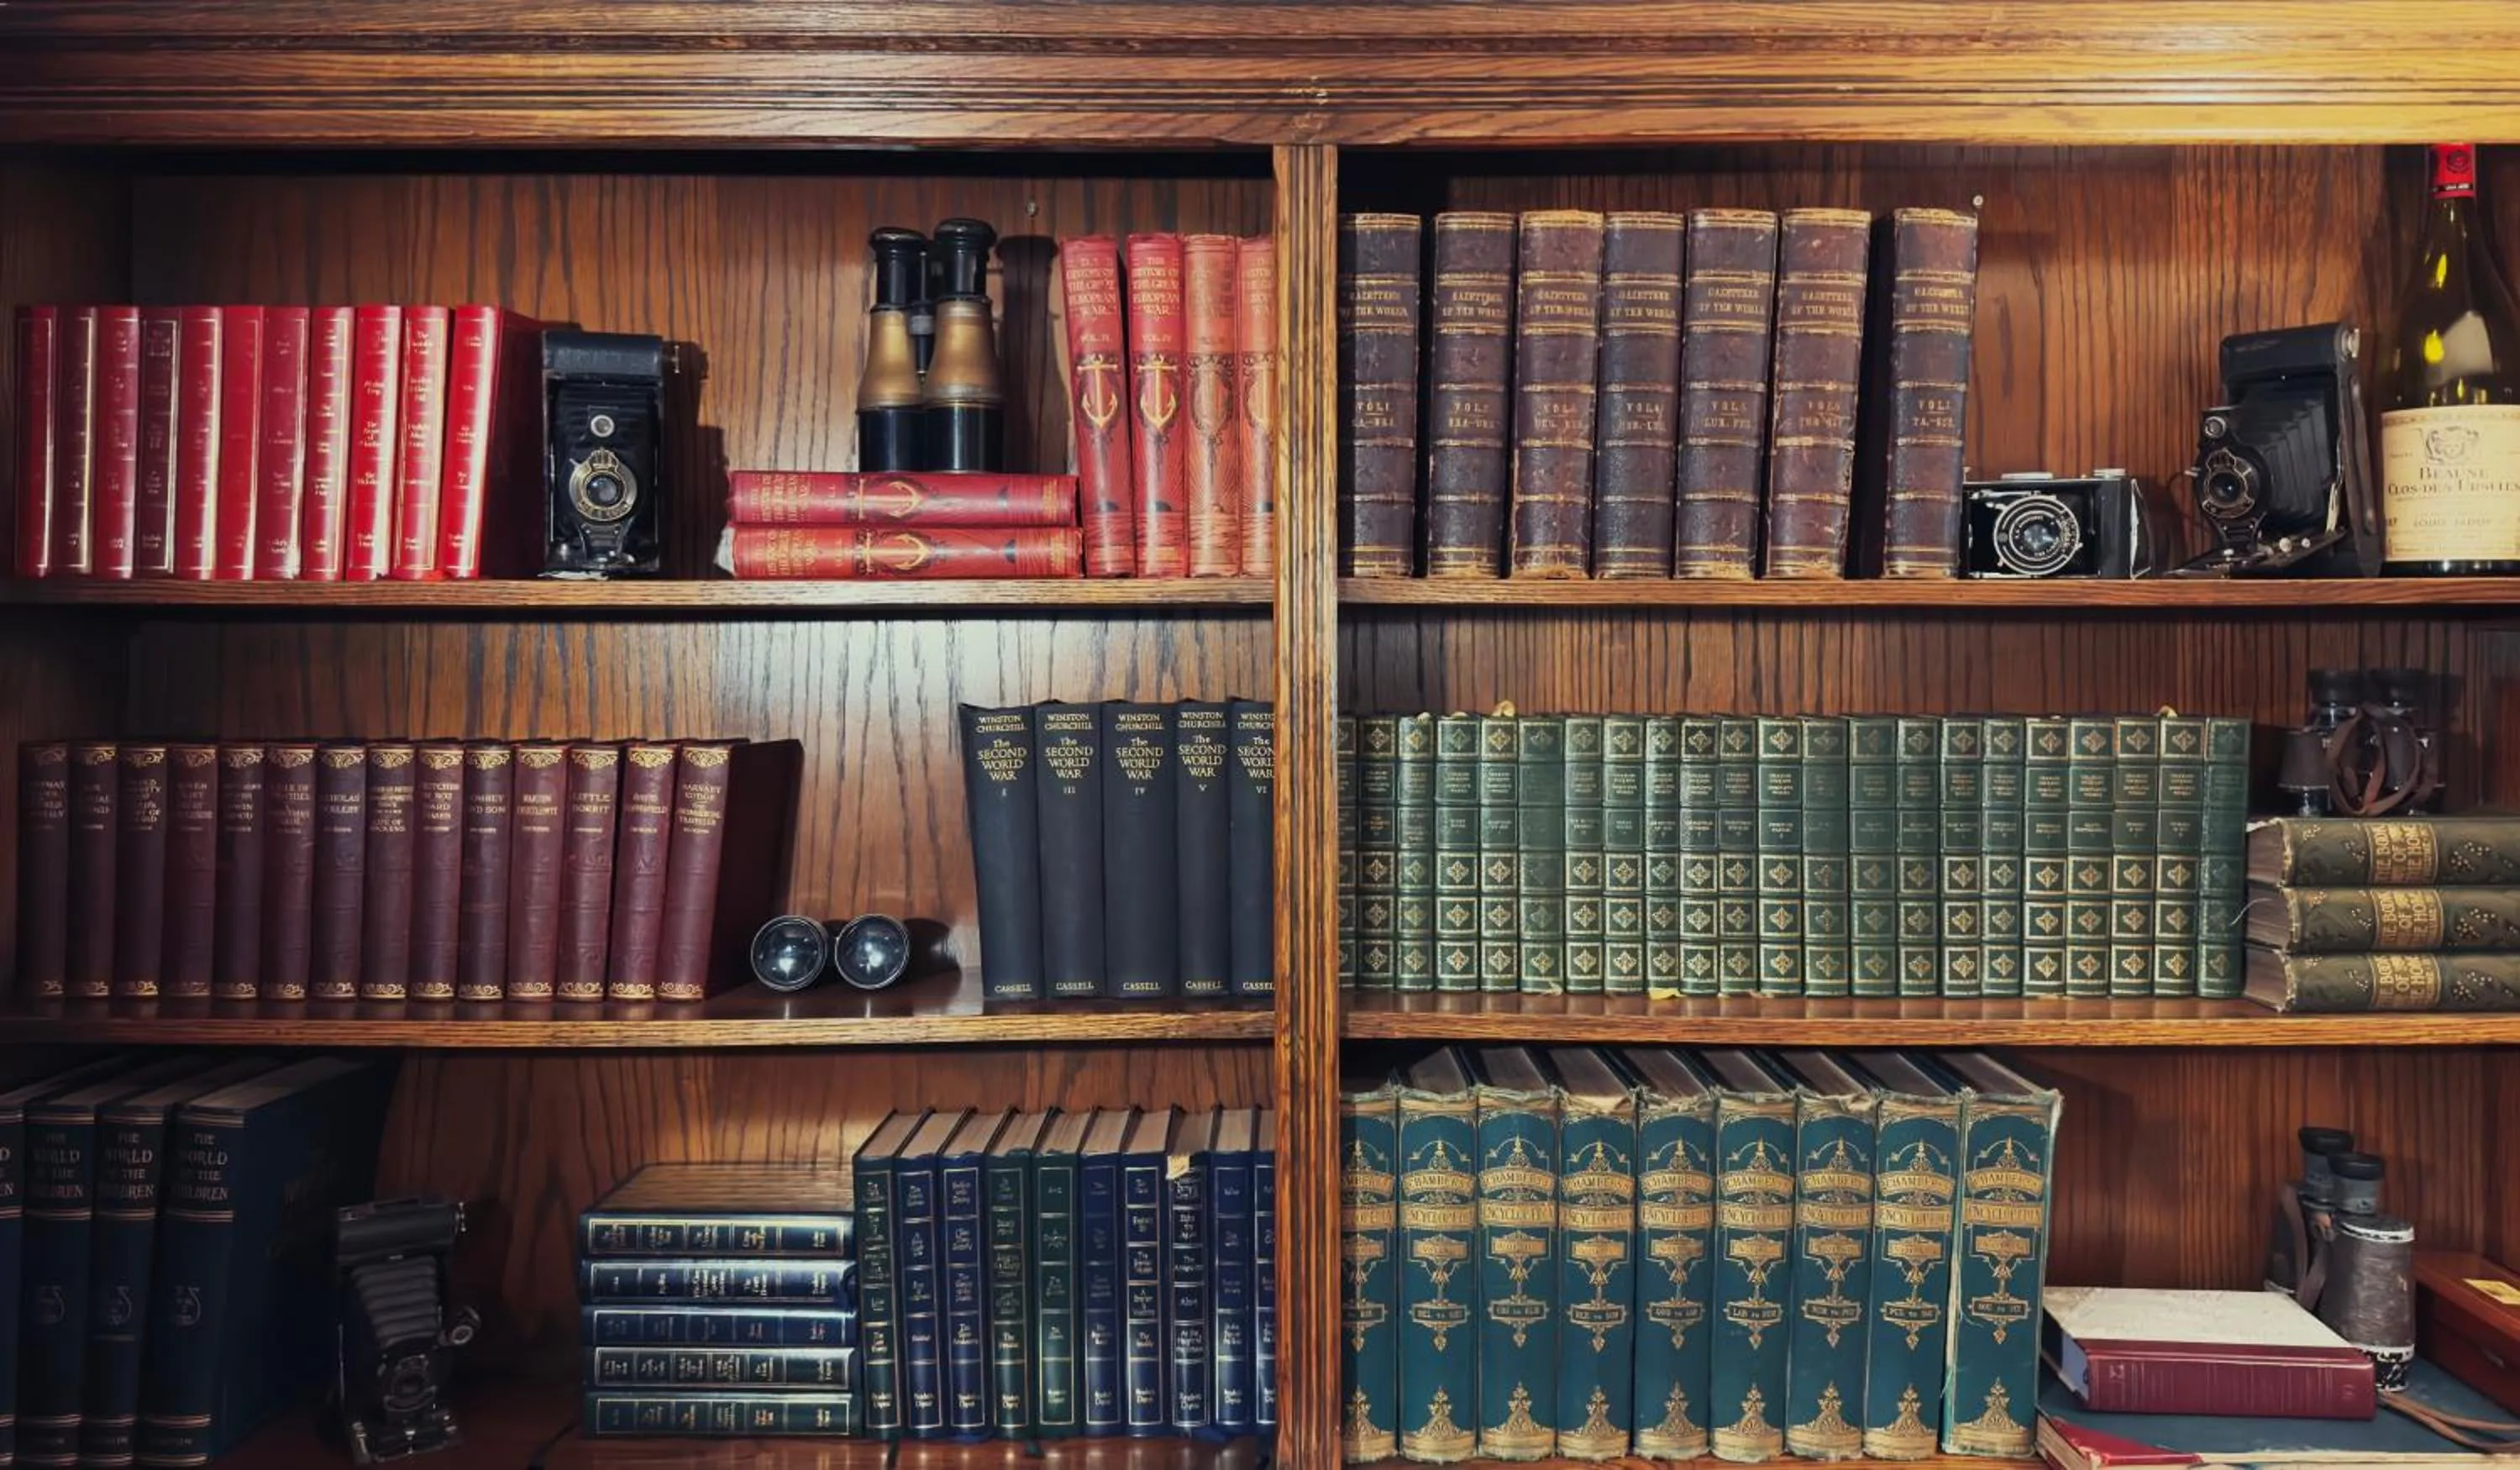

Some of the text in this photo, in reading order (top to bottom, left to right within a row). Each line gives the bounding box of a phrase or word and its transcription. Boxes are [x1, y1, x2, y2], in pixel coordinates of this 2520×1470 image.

[979, 715, 1021, 724] WINSTON
[1047, 713, 1089, 722] WINSTON
[1118, 713, 1160, 722] WINSTON
[1181, 711, 1224, 720] WINSTON
[976, 723, 1027, 733] CHURCHILL
[1045, 722, 1095, 730] CHURCHILL
[1115, 722, 1164, 731] CHURCHILL
[1178, 720, 1226, 729] CHURCHILL
[993, 738, 1011, 748] The
[1060, 737, 1078, 746] The
[1130, 736, 1148, 746] The
[1193, 734, 1211, 743] The
[1252, 736, 1270, 745] The
[978, 748, 1027, 760] SECOND
[1045, 747, 1095, 757] SECOND
[1116, 747, 1163, 758] SECOND
[1178, 744, 1228, 755] SECOND
[1237, 745, 1275, 757] SECON
[981, 759, 1024, 770] WORLD
[1048, 758, 1089, 768] WORLD
[1119, 759, 1160, 769] WORLD
[1182, 755, 1223, 765] WORLD
[1241, 757, 1275, 768] WORL
[990, 770, 1017, 781] WAR
[1056, 769, 1083, 779] WAR
[1126, 769, 1152, 780] WAR
[1189, 766, 1216, 777] WAR
[2393, 843, 2408, 863] OF
[2398, 907, 2413, 930] OF
[1056, 981, 1094, 991] CASSELL
[1123, 981, 1161, 991] CASSELL
[1184, 980, 1223, 990] CASSELL
[1242, 981, 1275, 991] CASSEL
[2396, 972, 2411, 993] OF
